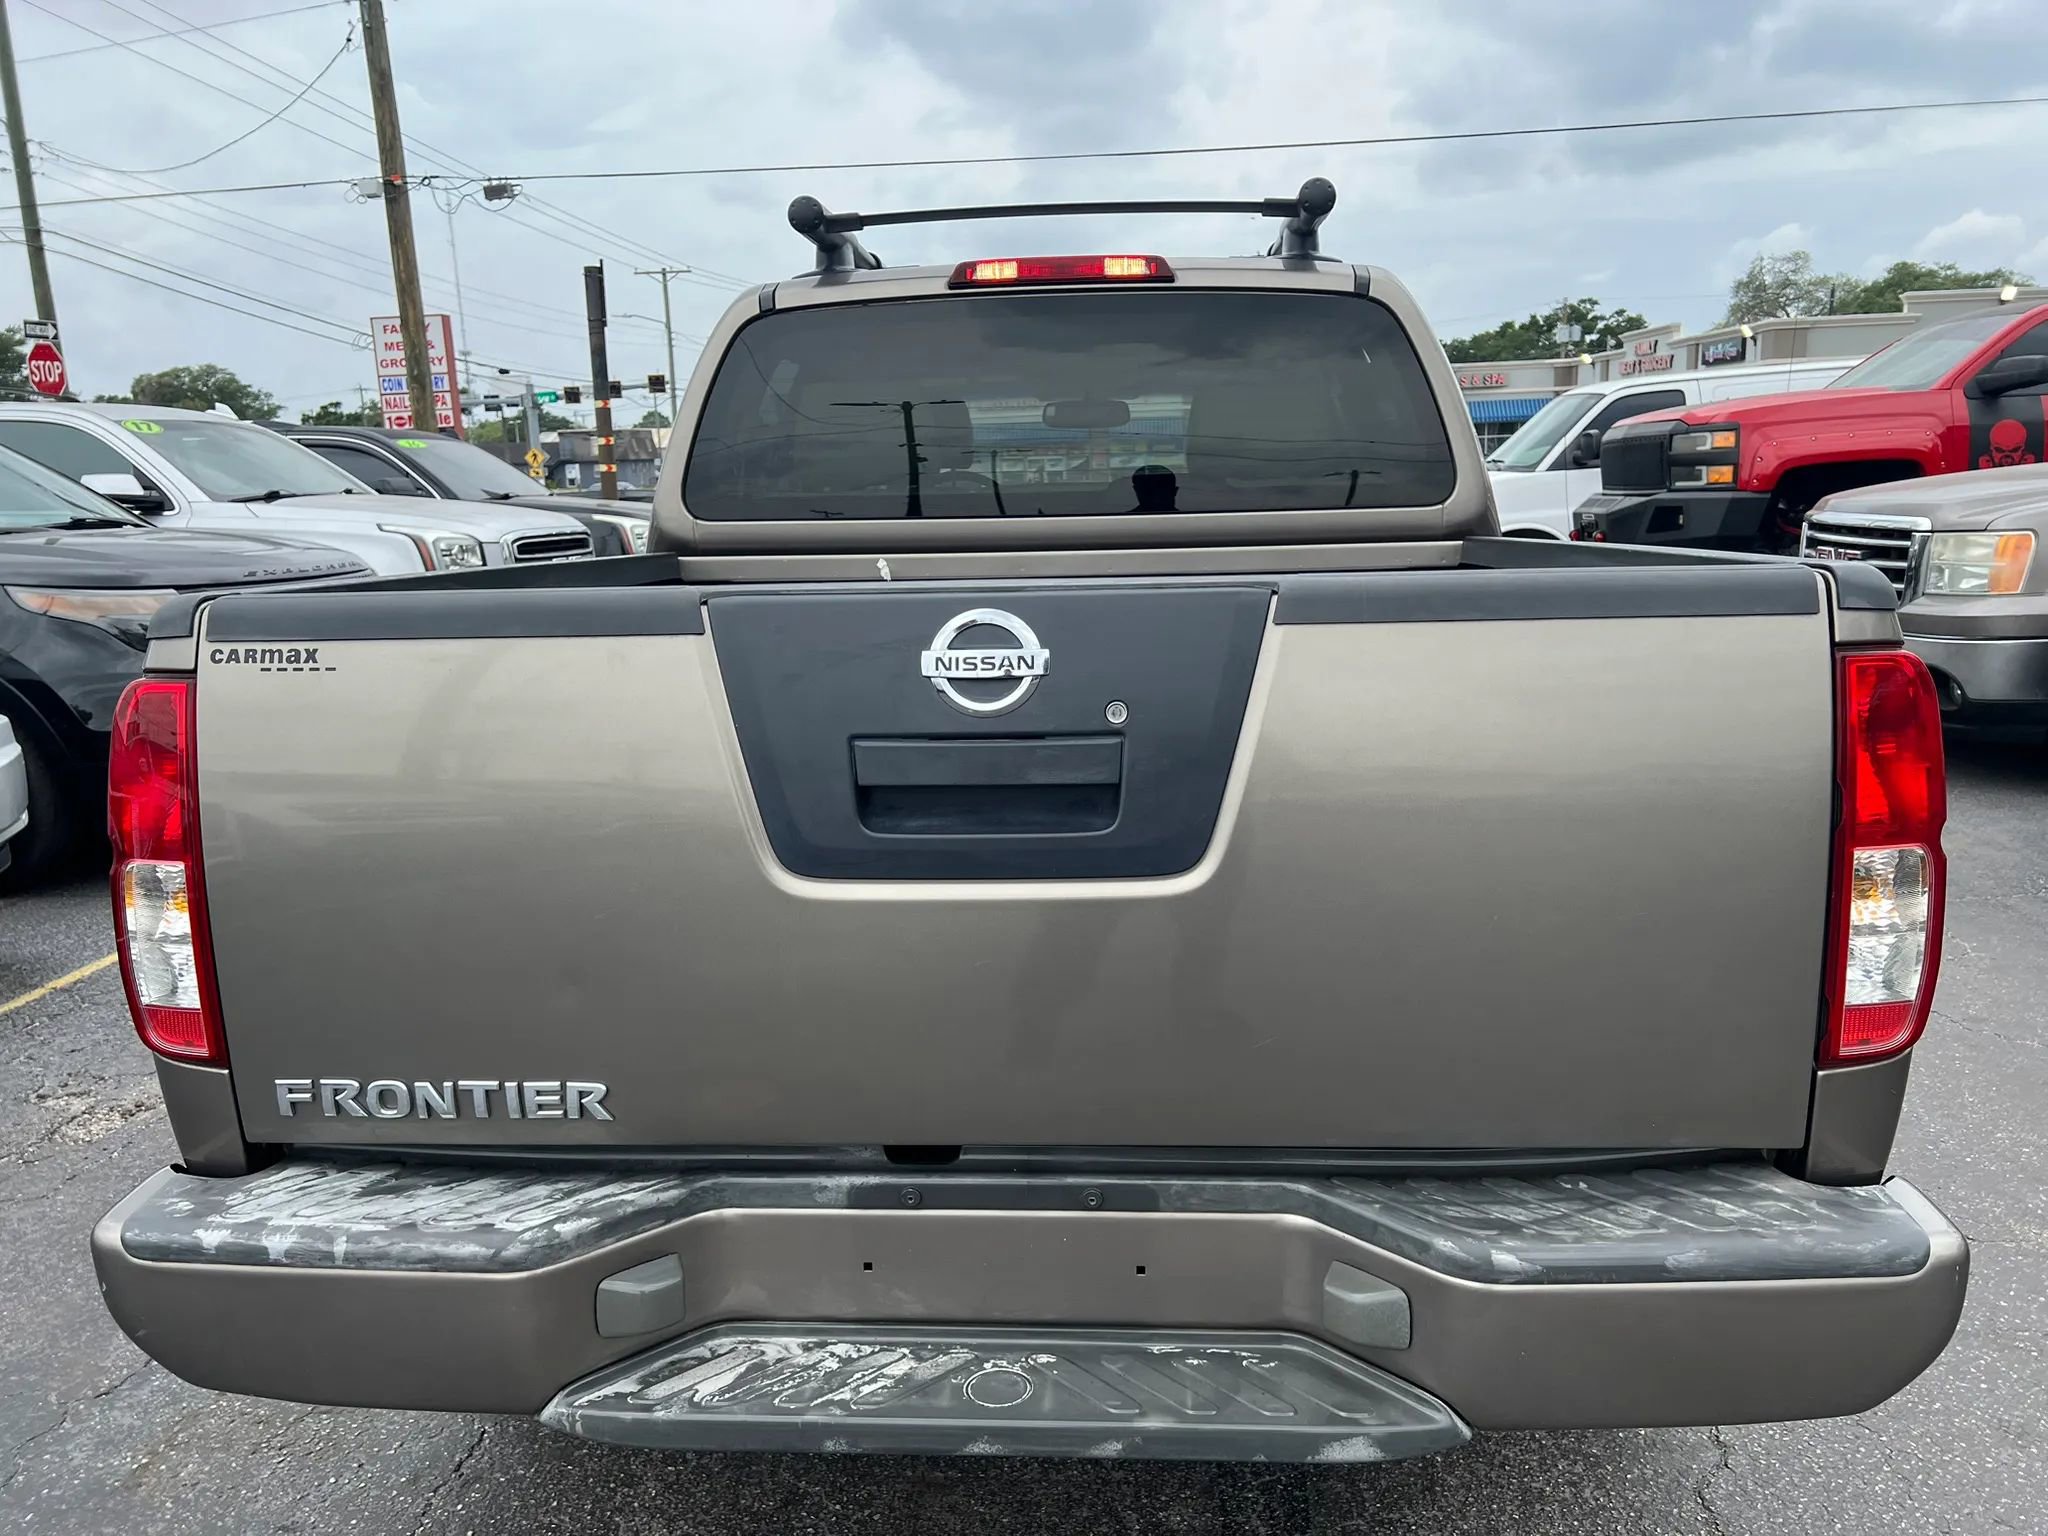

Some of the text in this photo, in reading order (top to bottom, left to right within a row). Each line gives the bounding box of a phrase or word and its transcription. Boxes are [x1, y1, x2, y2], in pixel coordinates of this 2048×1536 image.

[380, 356, 444, 369] GRORY
[30, 359, 62, 383] STOP
[382, 377, 403, 391] COIN
[1483, 372, 1505, 386] SPA
[385, 396, 411, 410] NAIL
[935, 655, 1035, 671] NISSAN
[274, 1079, 615, 1121] FRONTIER
